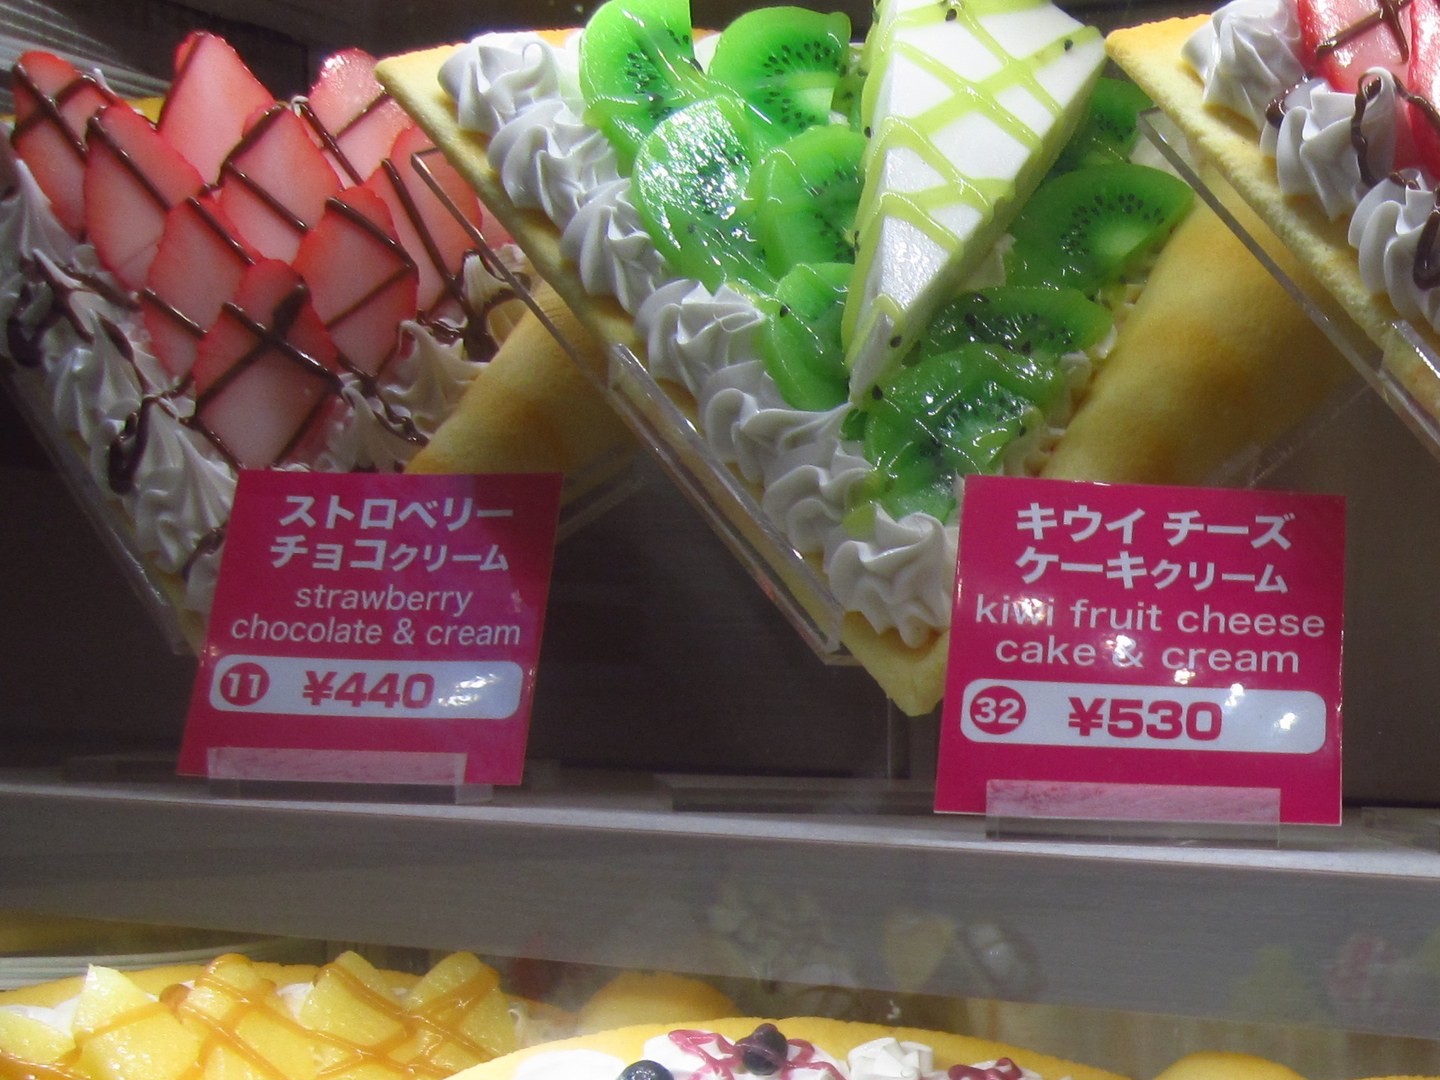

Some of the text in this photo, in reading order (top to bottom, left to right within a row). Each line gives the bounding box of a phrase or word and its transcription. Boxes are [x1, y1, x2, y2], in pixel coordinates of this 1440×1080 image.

[279, 495, 514, 532] ストロベリー
[1016, 502, 1295, 550] キウイ チーズ
[270, 534, 509, 572] チョコクリーム
[1015, 546, 1289, 593] ケーキクリーム
[295, 584, 473, 616] strawberry
[975, 595, 1325, 637] kiwi fruit cheese
[231, 614, 521, 645] chocolate & cream
[995, 636, 1299, 673] cake & cream
[229, 670, 435, 709] 11 ¥440
[974, 697, 1223, 741] 32 ¥530
